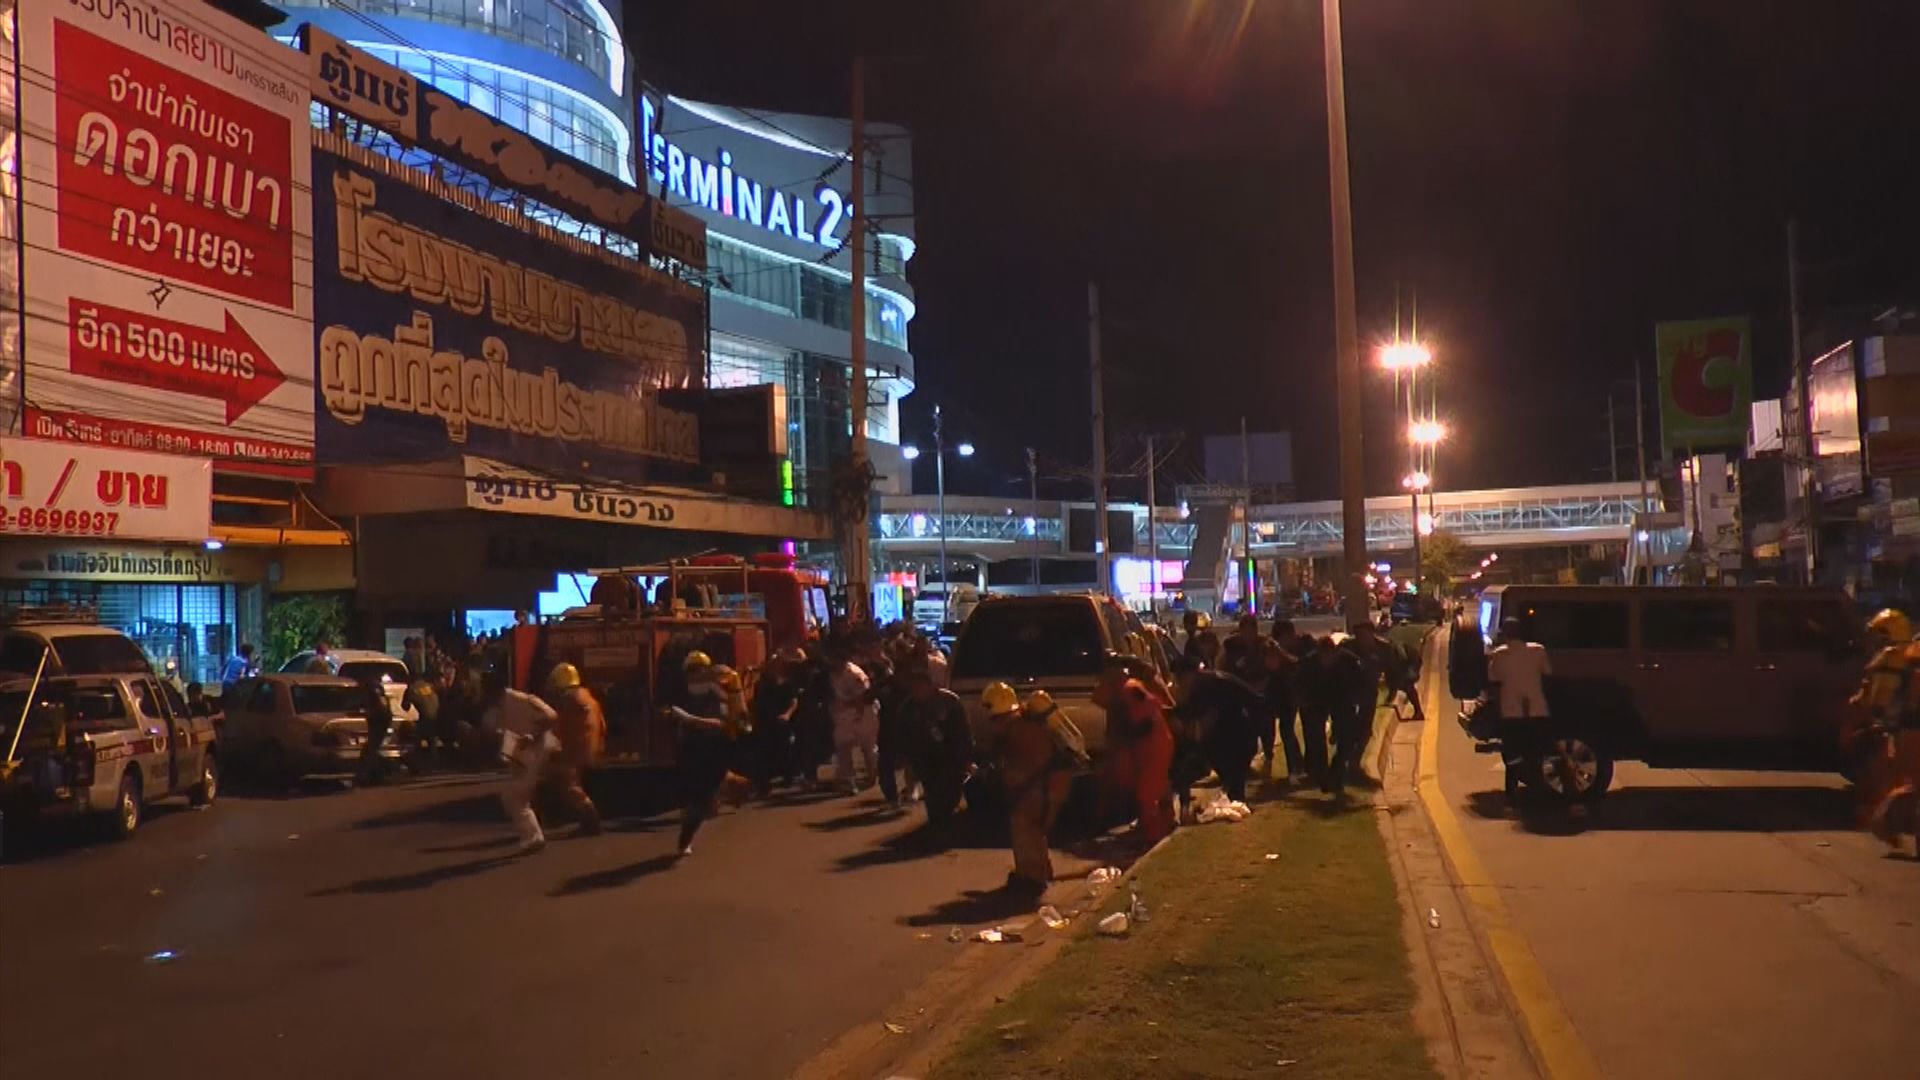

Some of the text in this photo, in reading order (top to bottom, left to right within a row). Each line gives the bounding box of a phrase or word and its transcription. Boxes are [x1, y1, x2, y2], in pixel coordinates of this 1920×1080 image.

[108, 67, 255, 154] จำนำกับเรา
[319, 44, 409, 116] ตู้แช่
[73, 111, 282, 231] ดอกเบา
[111, 202, 256, 278] กว่าเยอะ
[77, 307, 122, 354] อีก
[127, 323, 186, 367] 500
[191, 340, 256, 380] เมตร
[97, 470, 168, 507] ขาย
[877, 587, 894, 603] IN
